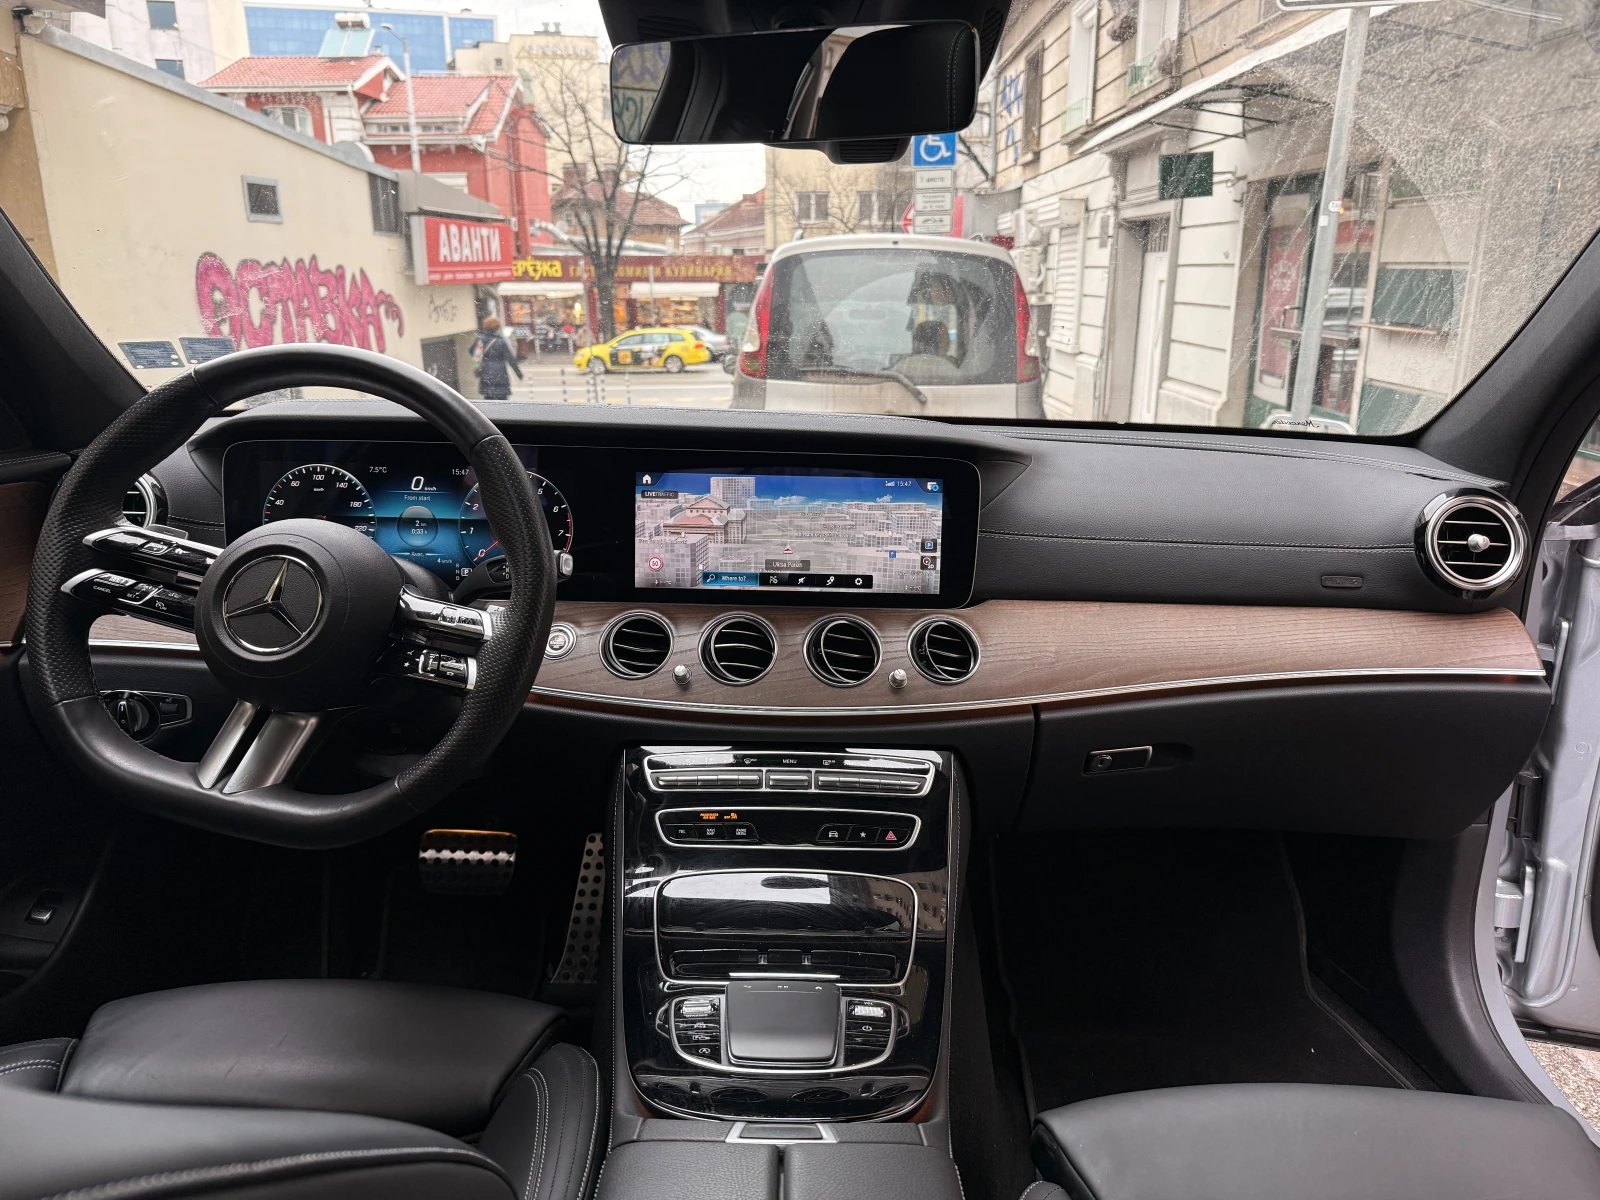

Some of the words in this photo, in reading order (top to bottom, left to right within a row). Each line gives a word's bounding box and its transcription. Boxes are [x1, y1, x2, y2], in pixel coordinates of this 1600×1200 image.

[439, 223, 501, 262] АВАНТИ
[451, 468, 470, 476] 15:47
[335, 481, 348, 489] 140
[410, 476, 425, 491] 0
[537, 488, 544, 496] 5
[469, 527, 475, 535] 1
[92, 585, 112, 594] CANCEL
